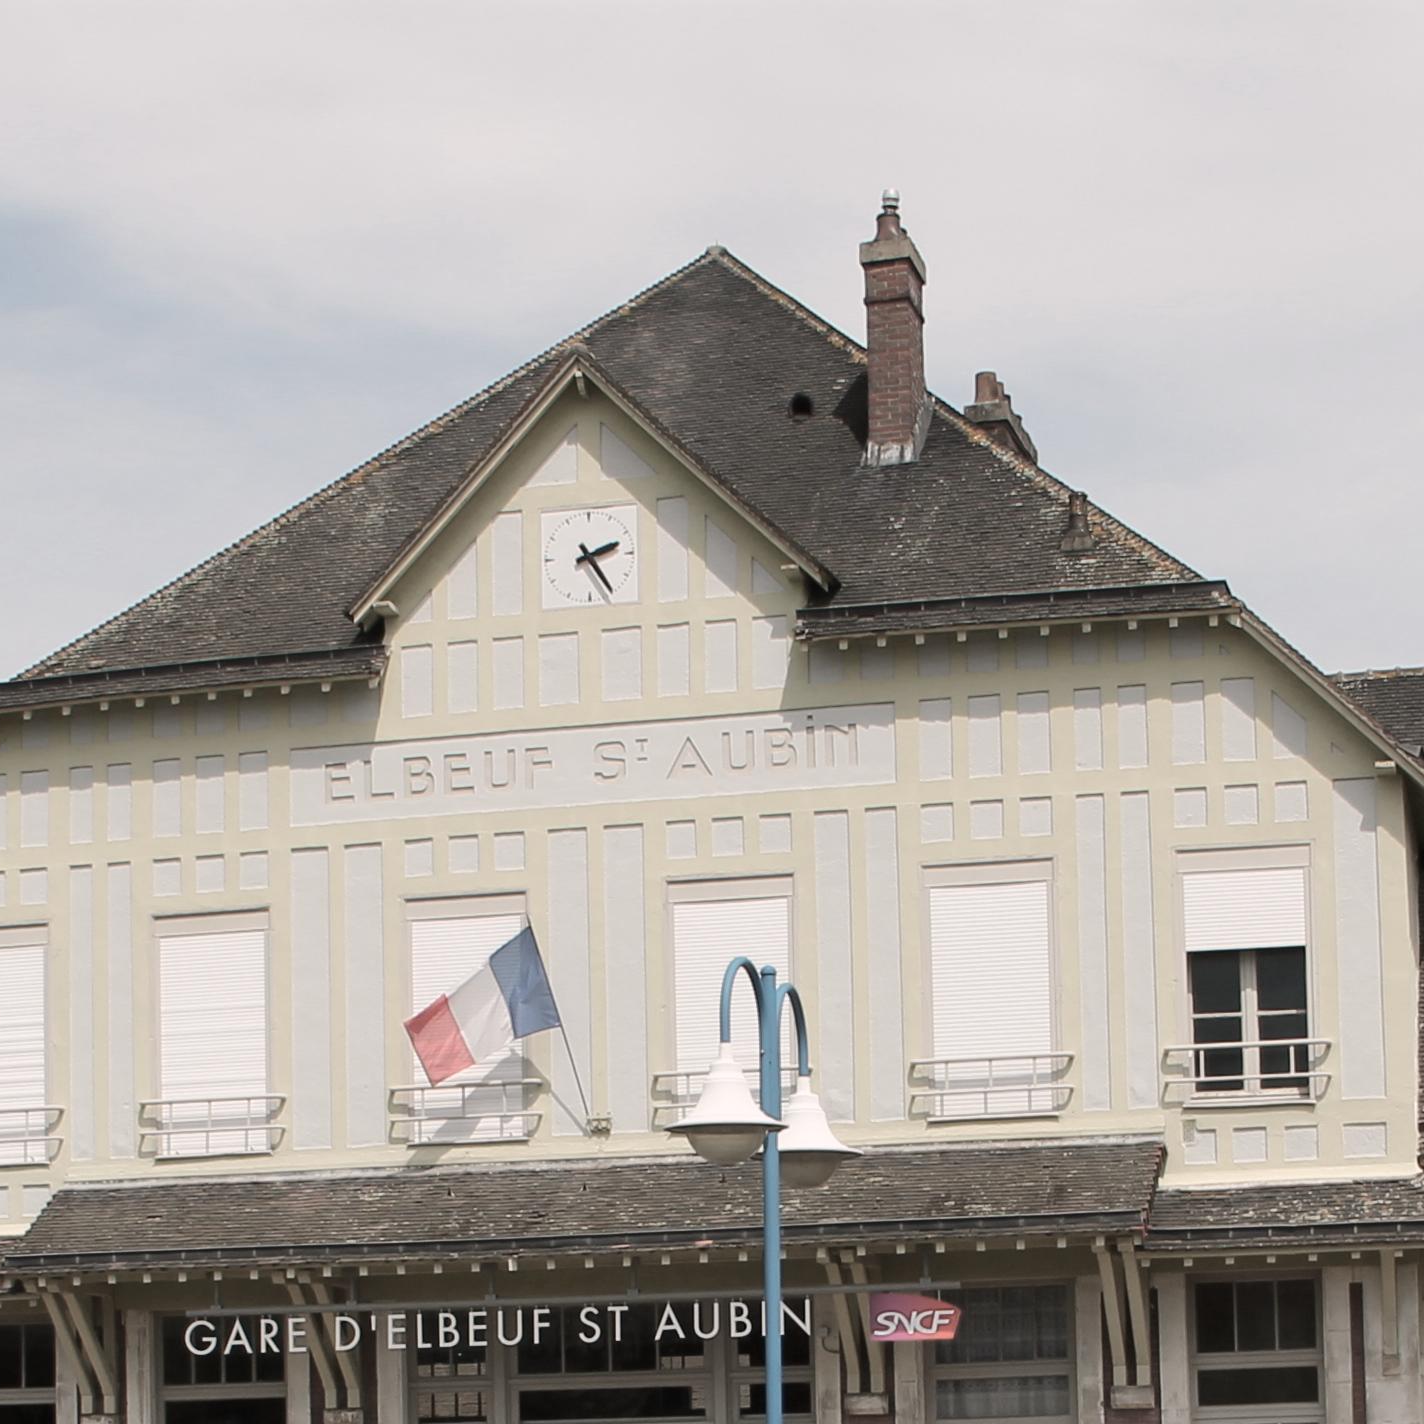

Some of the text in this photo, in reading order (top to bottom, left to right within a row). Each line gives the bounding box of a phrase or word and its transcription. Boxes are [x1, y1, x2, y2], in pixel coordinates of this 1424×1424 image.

[324, 746, 553, 803] ELBEUF
[184, 1298, 812, 1356] GARE D'ELBEUF ST AUBIN
[873, 1308, 955, 1336] SNCF
